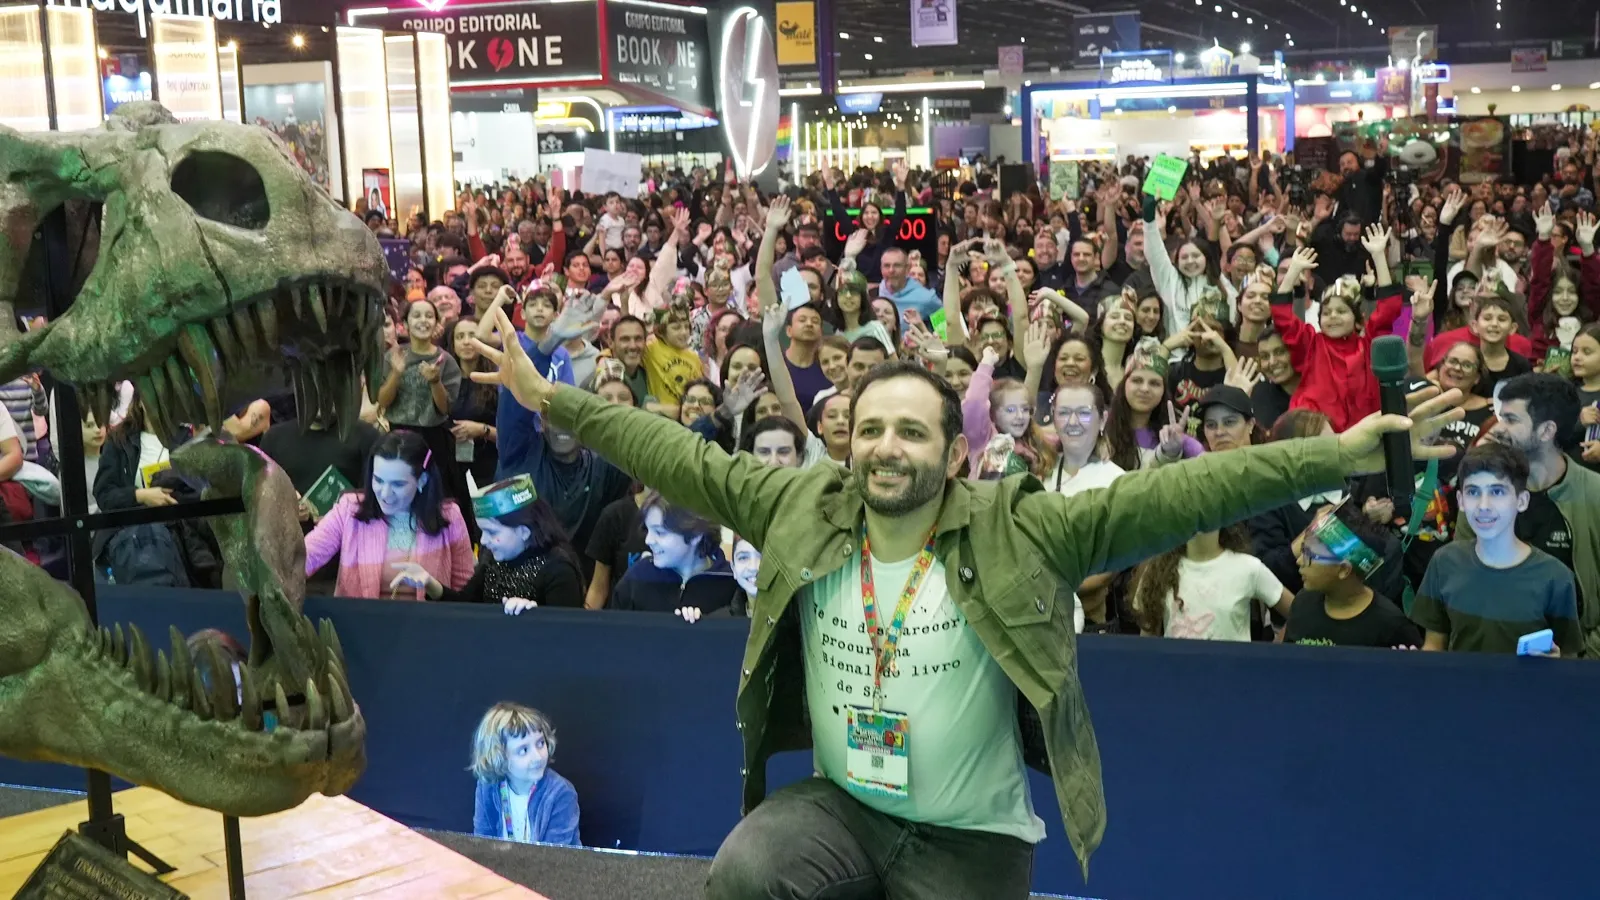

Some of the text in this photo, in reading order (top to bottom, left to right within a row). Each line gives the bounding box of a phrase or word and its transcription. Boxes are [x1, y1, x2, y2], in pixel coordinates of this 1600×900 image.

[459, 12, 541, 33] EDITORIAL
[617, 34, 661, 65] BOOK
[832, 616, 847, 629] eu
[911, 659, 961, 678] livro
[836, 679, 853, 694] de
